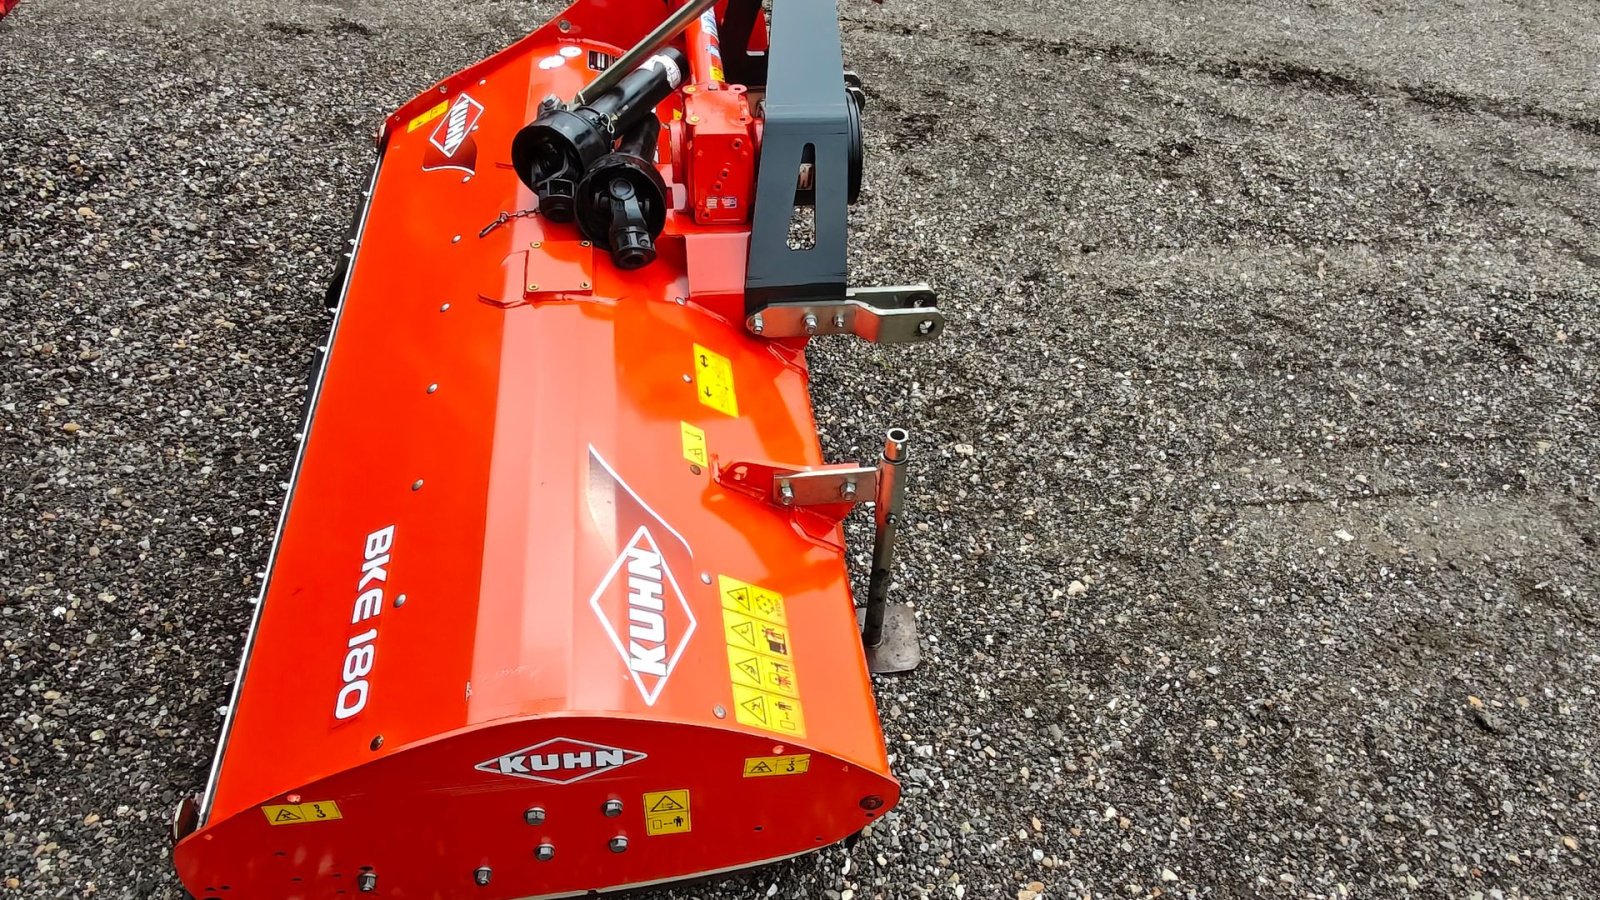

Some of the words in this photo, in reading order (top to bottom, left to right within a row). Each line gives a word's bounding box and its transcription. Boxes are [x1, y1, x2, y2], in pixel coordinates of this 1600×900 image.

[443, 98, 470, 152] KUHN
[352, 524, 395, 625] BKE
[627, 546, 667, 677] KUHN
[334, 628, 378, 720] 180
[499, 750, 624, 774] KUHN
